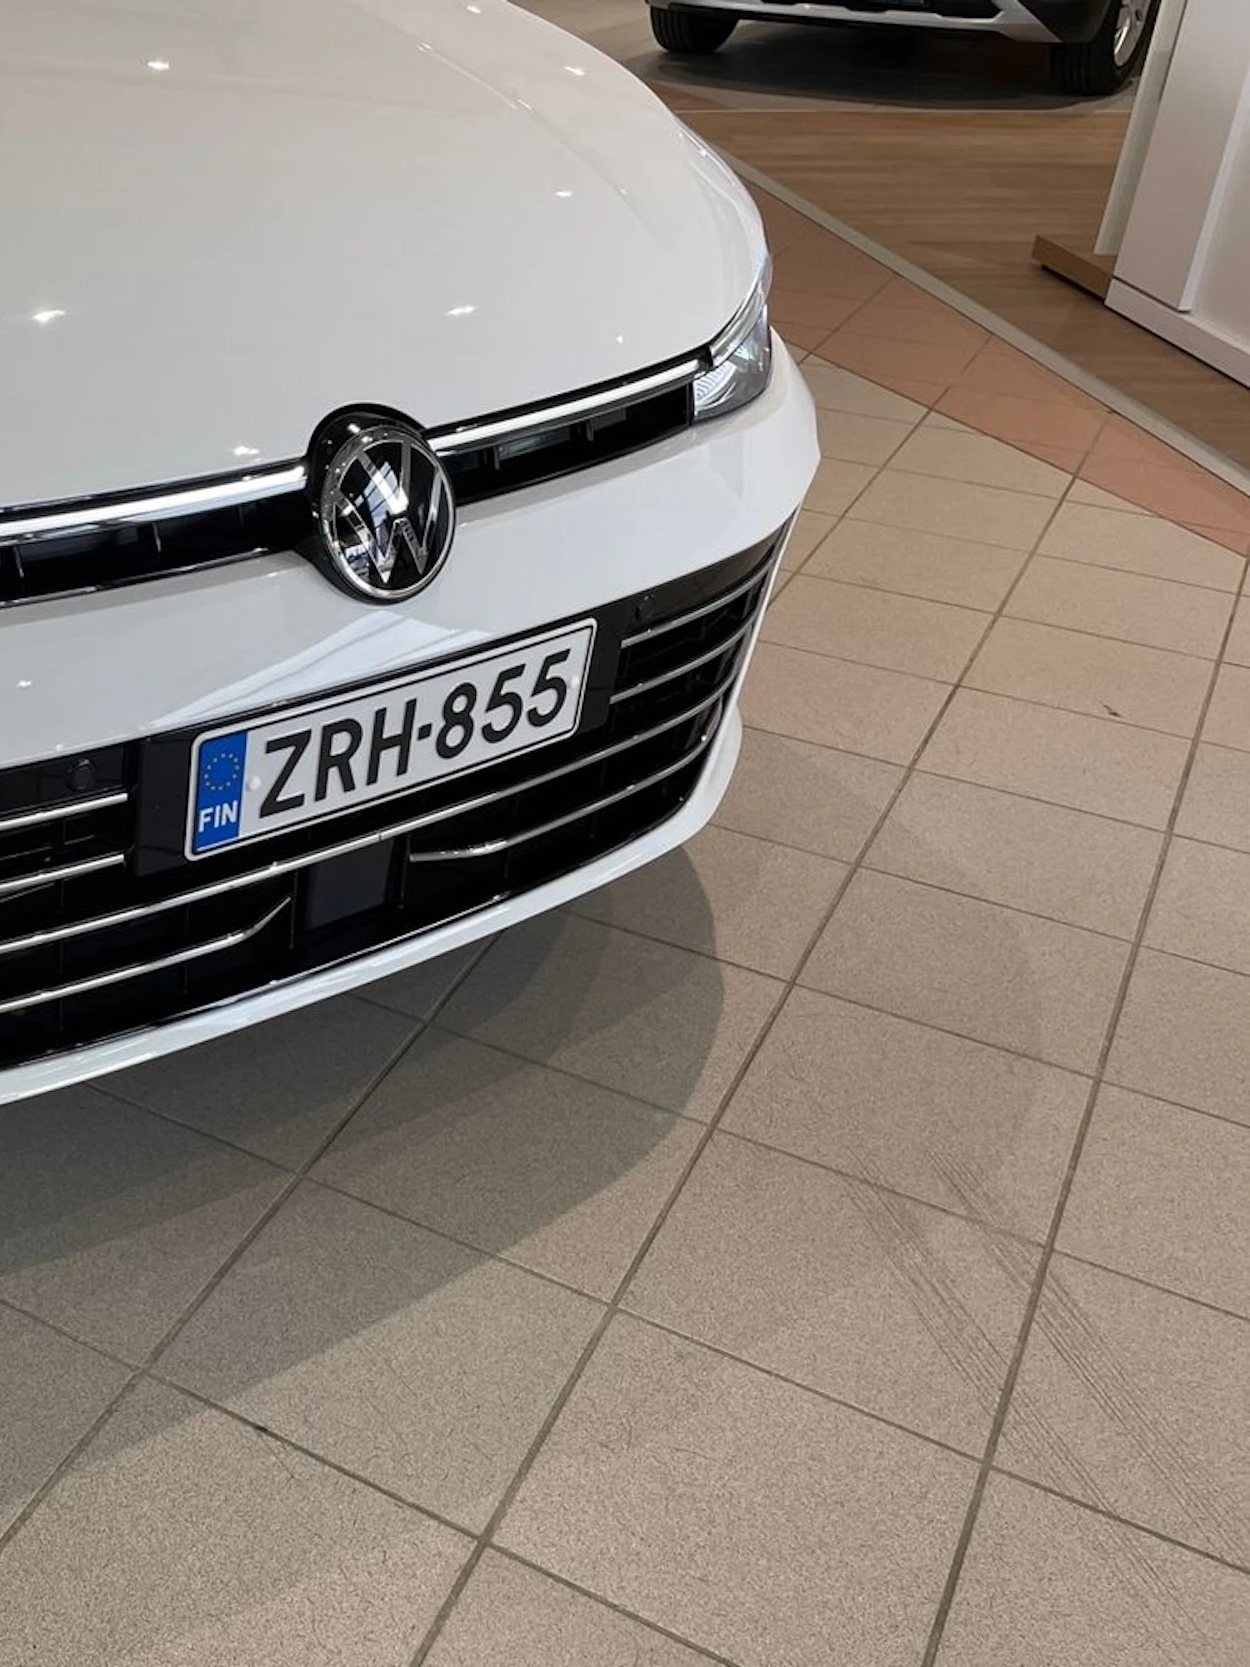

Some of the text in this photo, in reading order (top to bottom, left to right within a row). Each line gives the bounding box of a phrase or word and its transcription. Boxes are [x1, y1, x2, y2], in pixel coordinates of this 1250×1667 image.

[330, 436, 444, 585] VW
[259, 649, 571, 818] ZRH-855
[198, 800, 238, 832] FIN
